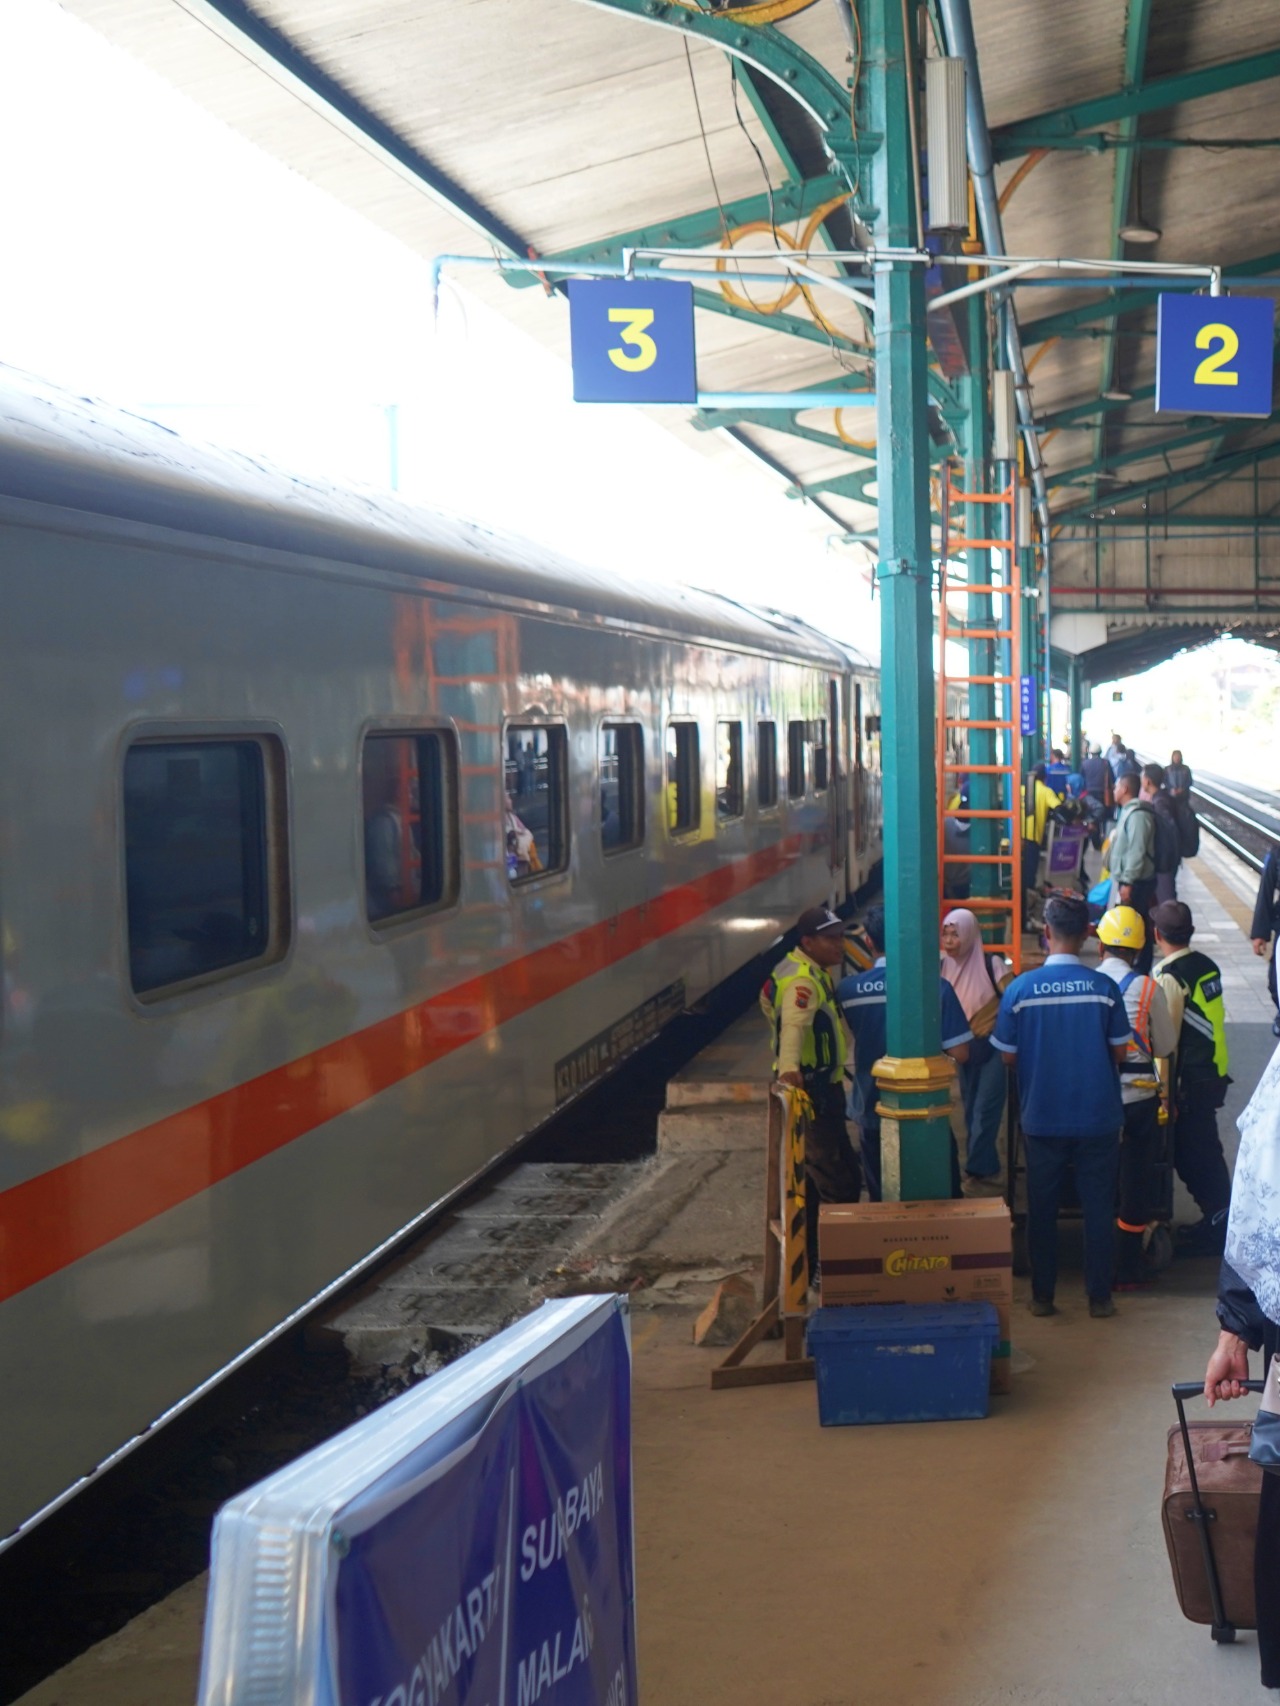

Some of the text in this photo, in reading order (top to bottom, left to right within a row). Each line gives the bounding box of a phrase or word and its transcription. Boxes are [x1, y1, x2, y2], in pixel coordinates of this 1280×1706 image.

[607, 308, 658, 372] 3
[1194, 323, 1239, 386] 2
[1021, 677, 1030, 731] MADIUN
[1034, 980, 1095, 995] LOGISTIK
